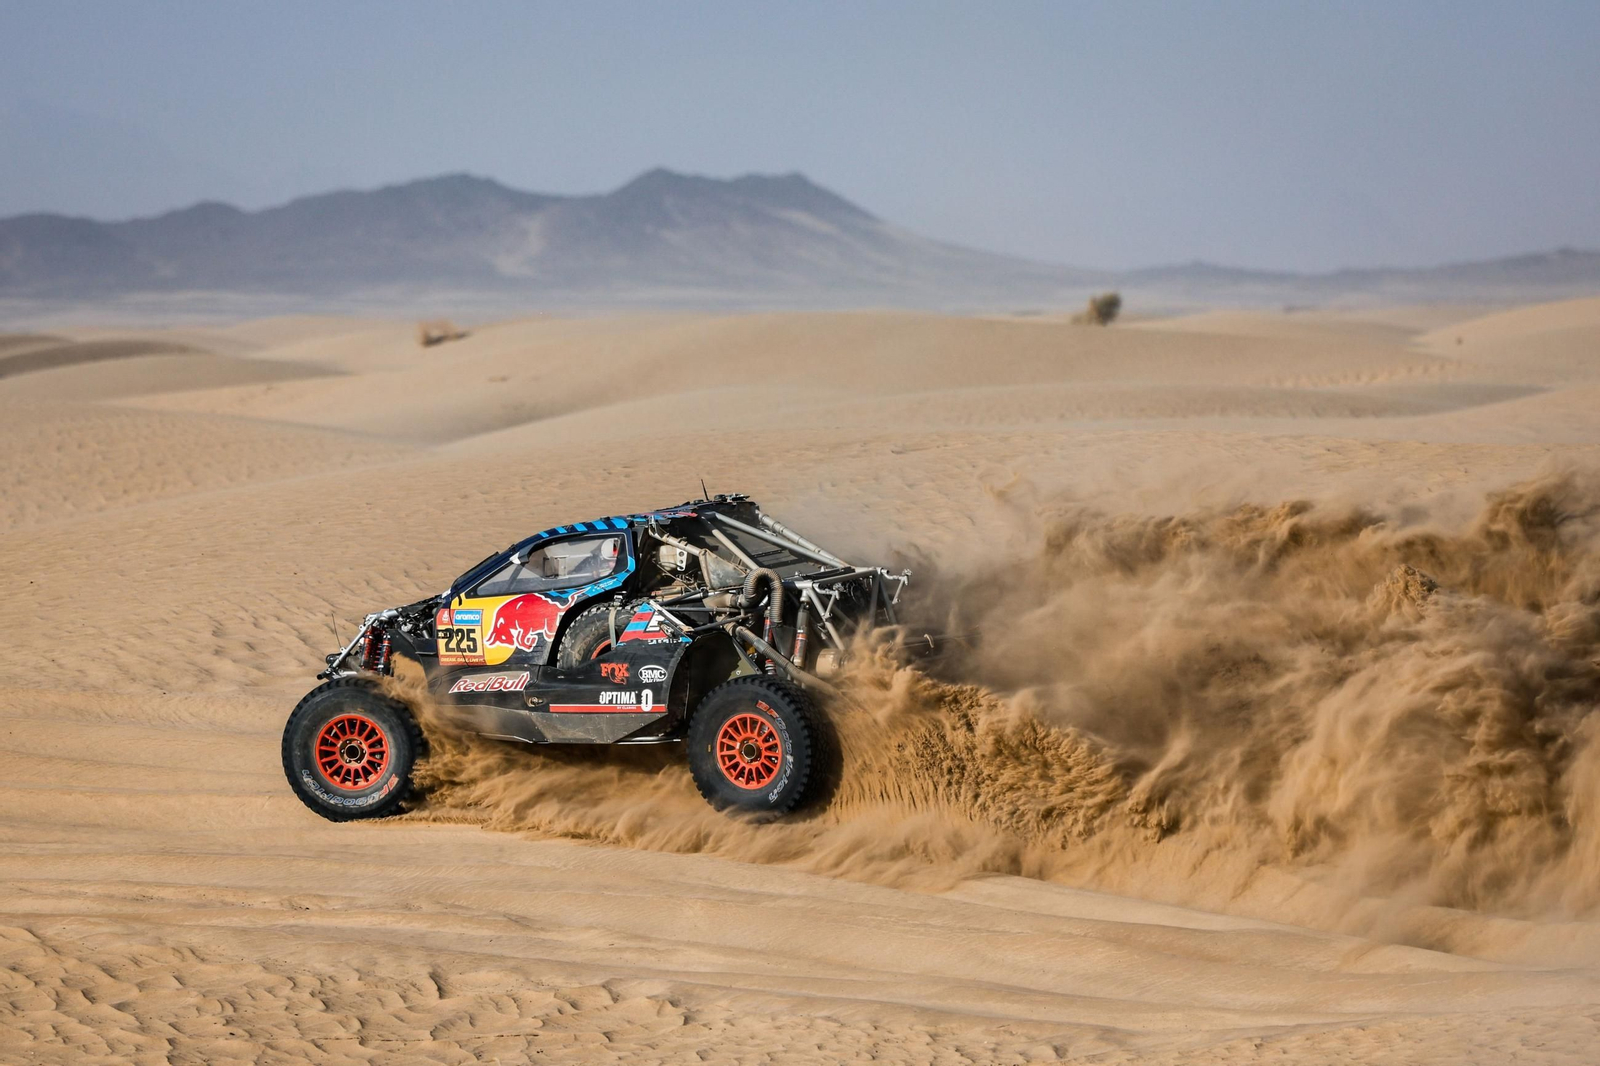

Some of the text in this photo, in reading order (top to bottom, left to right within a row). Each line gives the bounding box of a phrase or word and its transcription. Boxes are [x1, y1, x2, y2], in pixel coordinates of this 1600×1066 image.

[444, 627, 478, 653] 225
[600, 663, 630, 681] FOX
[641, 669, 665, 679] BMC
[448, 671, 530, 693] Red Bull
[599, 691, 637, 704] OPTIMA
